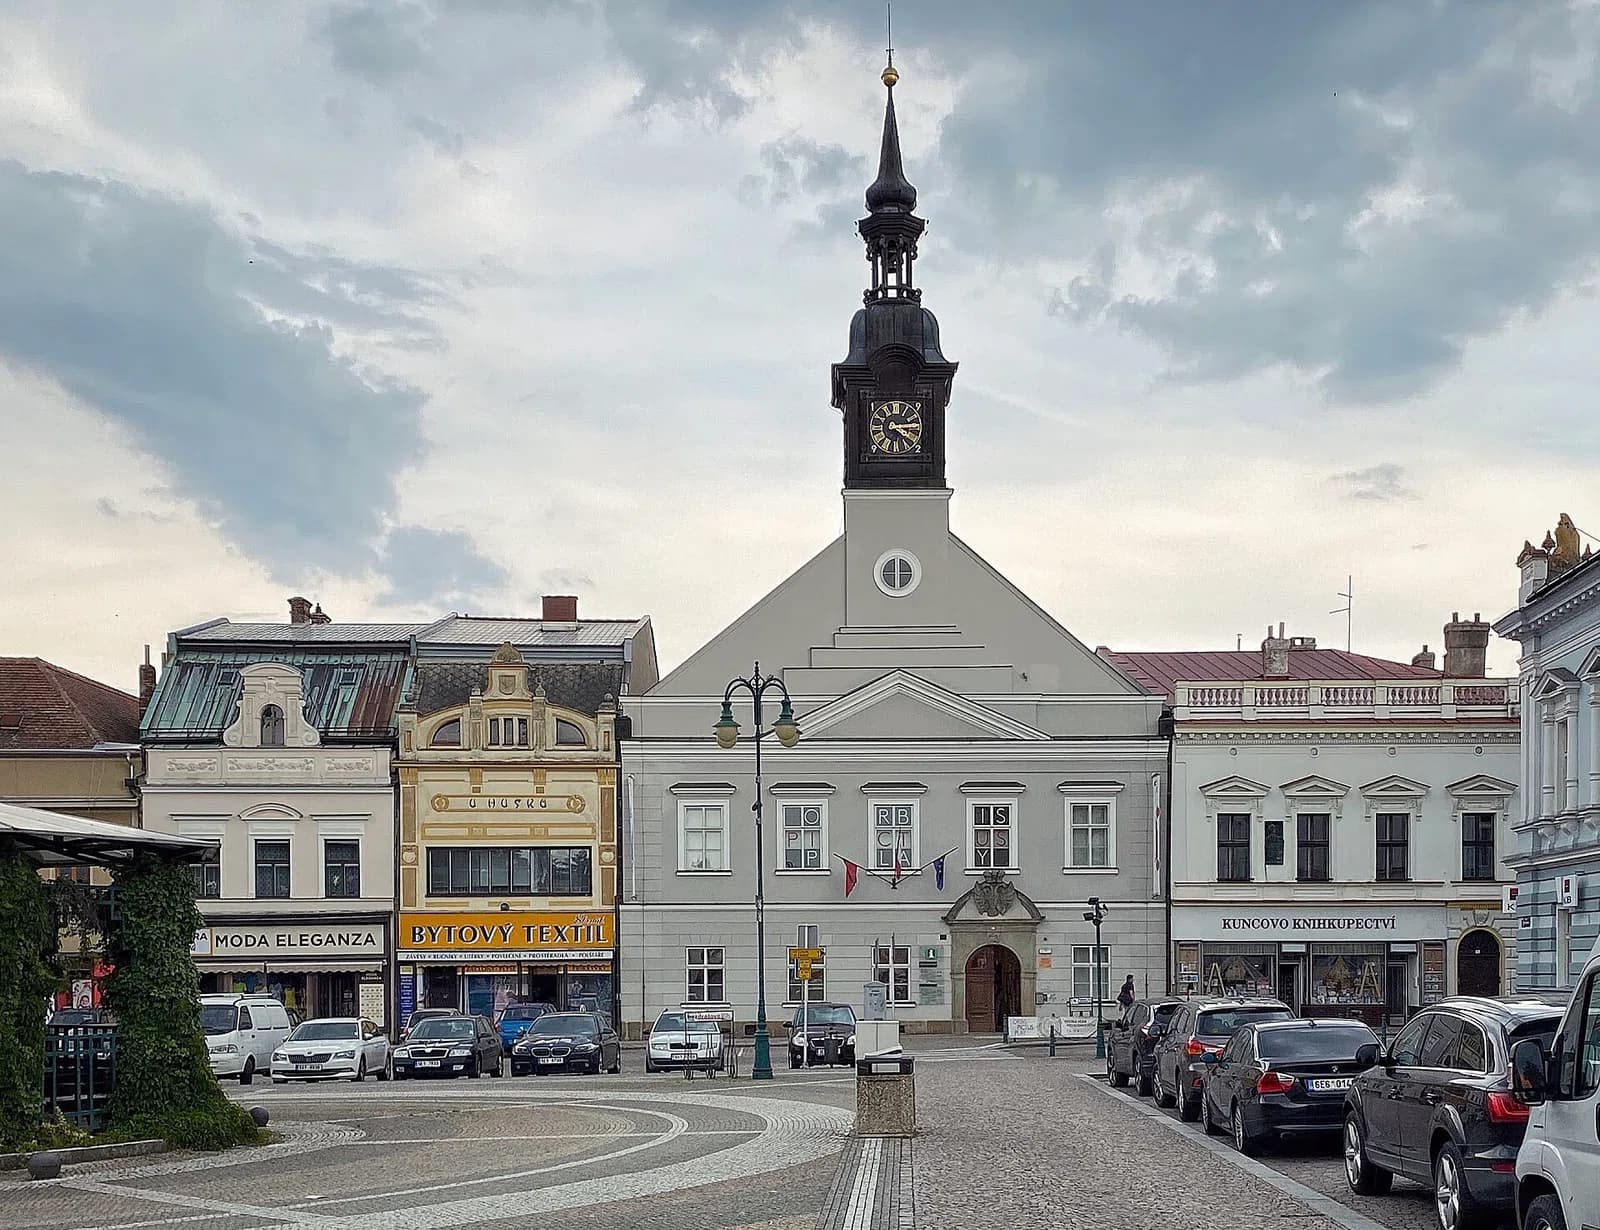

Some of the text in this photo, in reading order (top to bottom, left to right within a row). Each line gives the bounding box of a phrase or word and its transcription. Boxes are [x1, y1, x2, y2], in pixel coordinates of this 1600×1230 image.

[871, 402, 875, 412] 1
[915, 402, 922, 412] 9
[915, 445, 922, 454] 2
[469, 798, 477, 809] U
[1221, 915, 1396, 930] KUNCOVO KNIHKUPECTVÍ
[411, 923, 609, 945] BYTOVÝ TEXTIL
[215, 933, 376, 948] MODA ELEGANZA
